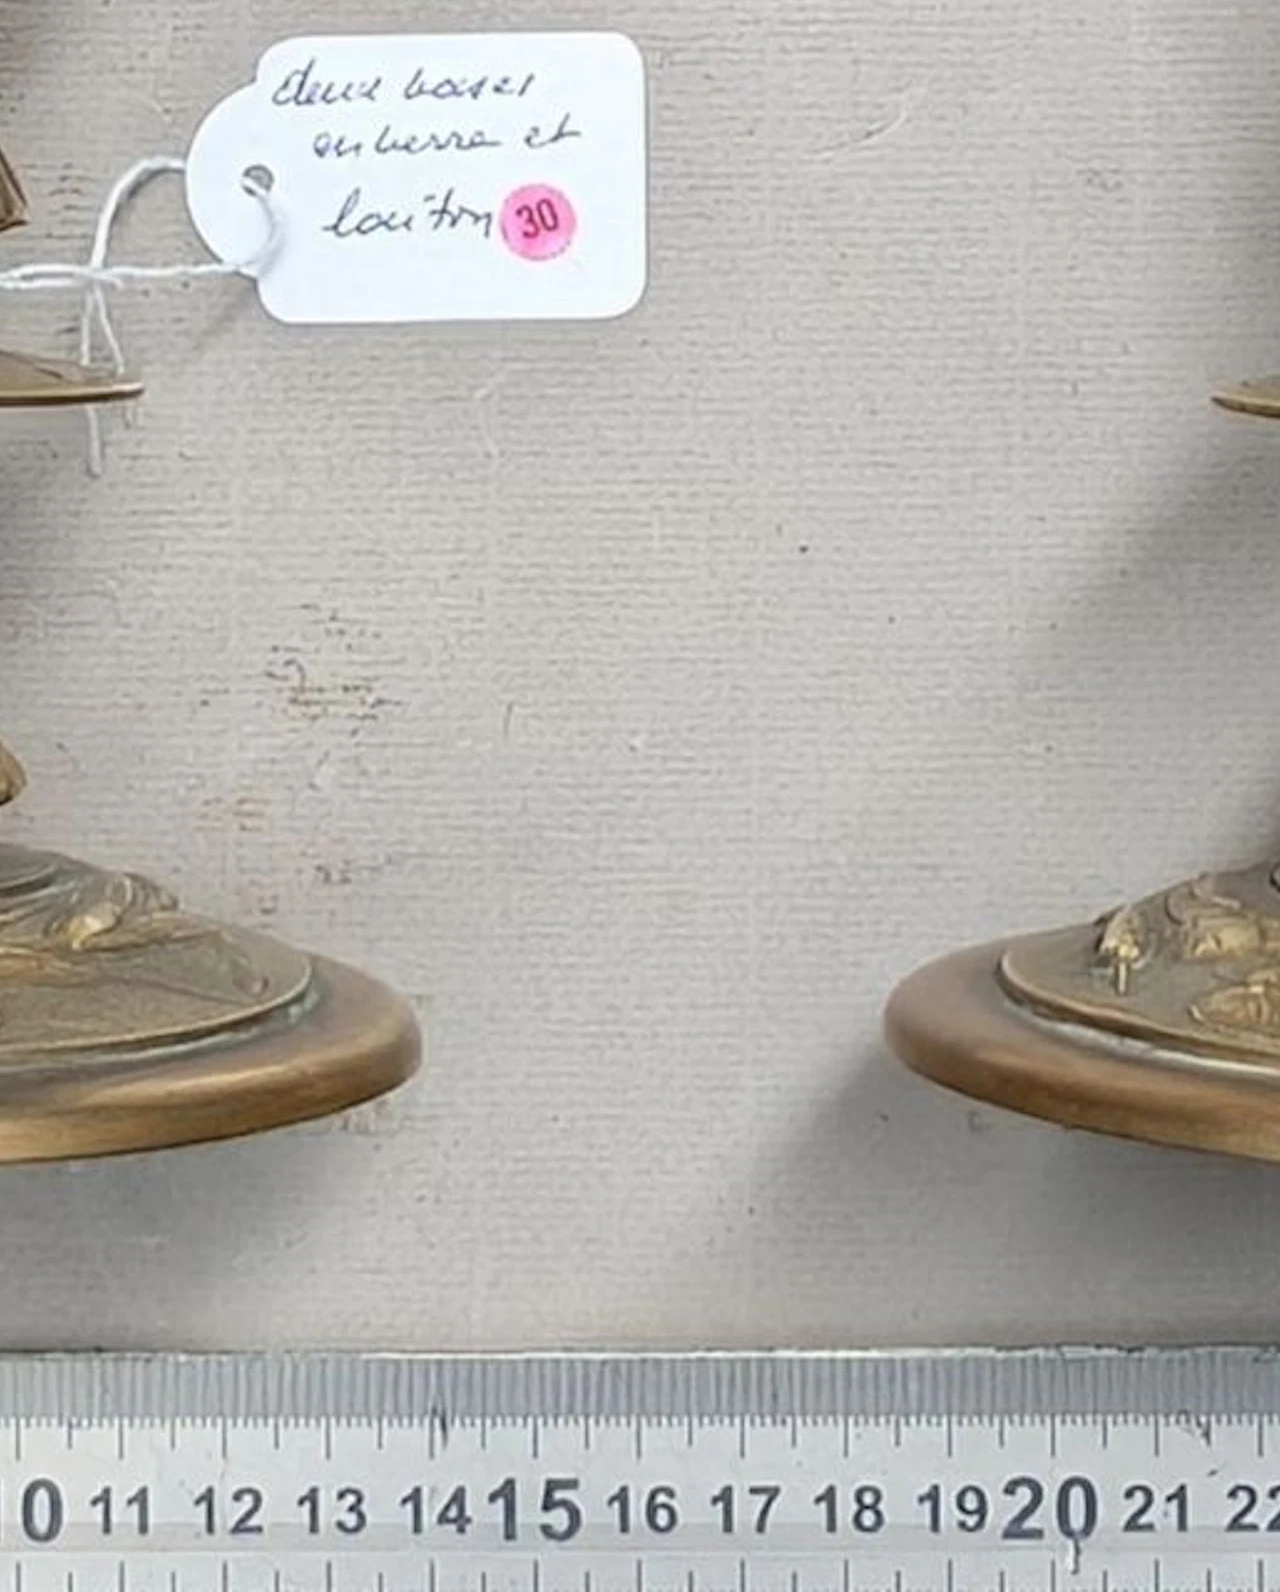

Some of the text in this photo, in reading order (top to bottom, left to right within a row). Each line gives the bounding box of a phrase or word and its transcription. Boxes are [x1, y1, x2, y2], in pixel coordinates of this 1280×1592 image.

[523, 112, 582, 148] et
[515, 197, 560, 240] 30
[88, 1484, 150, 1537] 11
[192, 1484, 265, 1539] 12
[296, 1485, 368, 1536] 13
[399, 1484, 474, 1536] 14
[486, 1476, 583, 1544] 15
[605, 1484, 679, 1536] 16
[709, 1483, 782, 1536] 17
[813, 1483, 886, 1535] 18
[916, 1482, 990, 1535] 19
[1000, 1475, 1099, 1542] 20
[1121, 1482, 1189, 1534] 21
